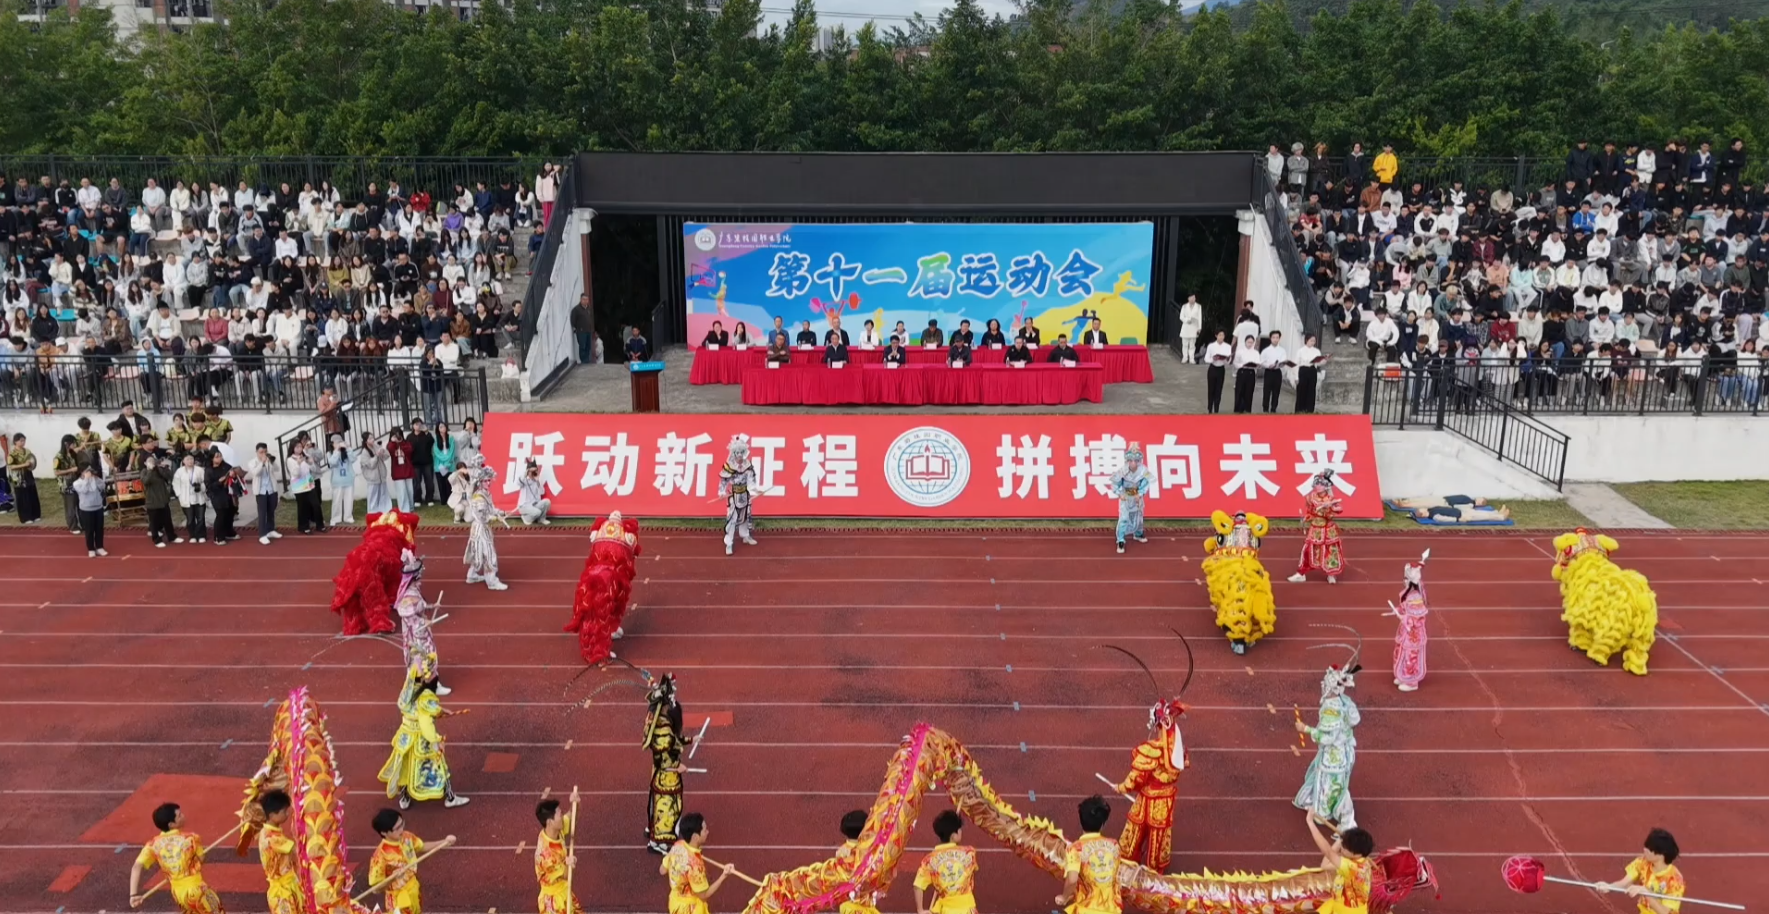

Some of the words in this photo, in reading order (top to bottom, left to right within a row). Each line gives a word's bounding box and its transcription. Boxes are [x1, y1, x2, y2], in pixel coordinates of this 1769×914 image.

[766, 249, 1103, 302] 第十一届运动会
[995, 433, 1356, 500] 拼搏向未来
